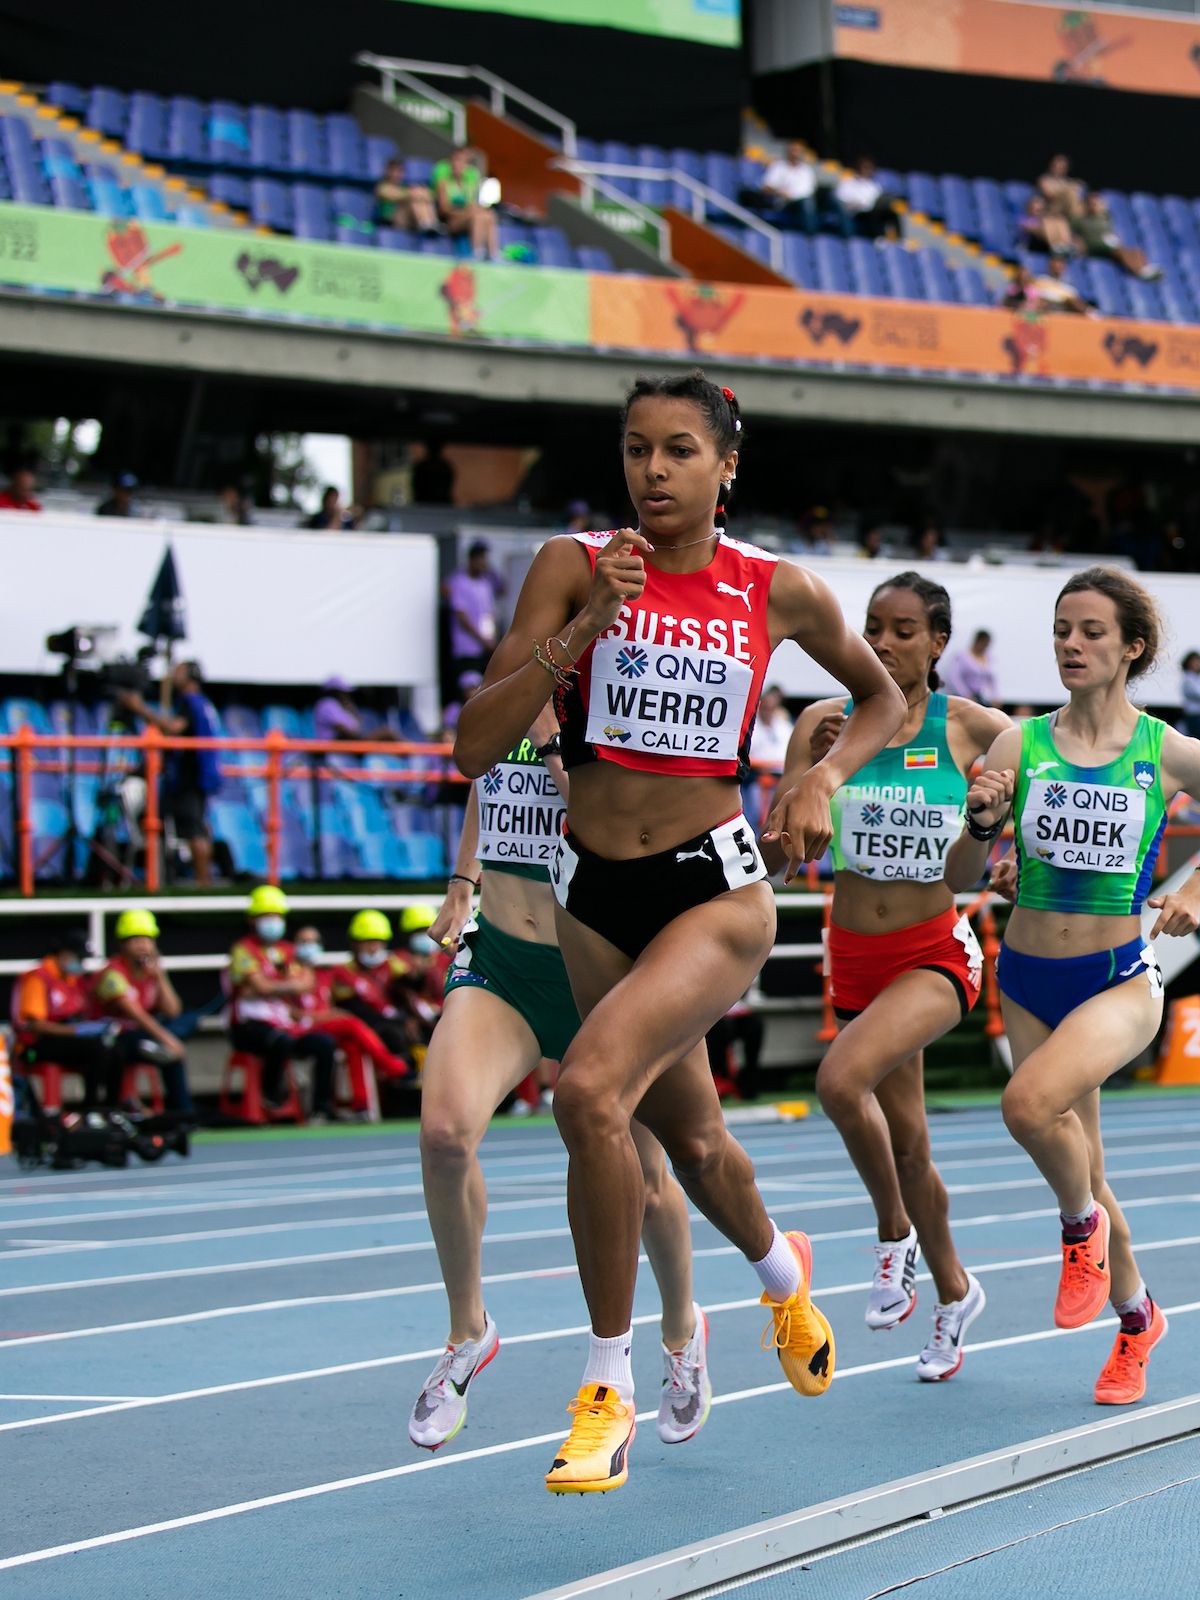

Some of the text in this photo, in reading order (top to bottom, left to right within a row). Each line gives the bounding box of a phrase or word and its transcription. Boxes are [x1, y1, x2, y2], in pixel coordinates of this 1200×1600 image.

[655, 654, 728, 685] QNB
[606, 683, 728, 729] WERRO
[641, 730, 721, 753] CALI 22
[1072, 788, 1128, 812] QNB
[890, 807, 943, 829] QNB
[1036, 814, 1127, 848] SADEK
[497, 841, 533, 858] CALI
[733, 827, 758, 875] 5
[851, 831, 949, 860] TESFAY
[1063, 850, 1125, 867] CALI 22
[883, 865, 919, 879] CALI
